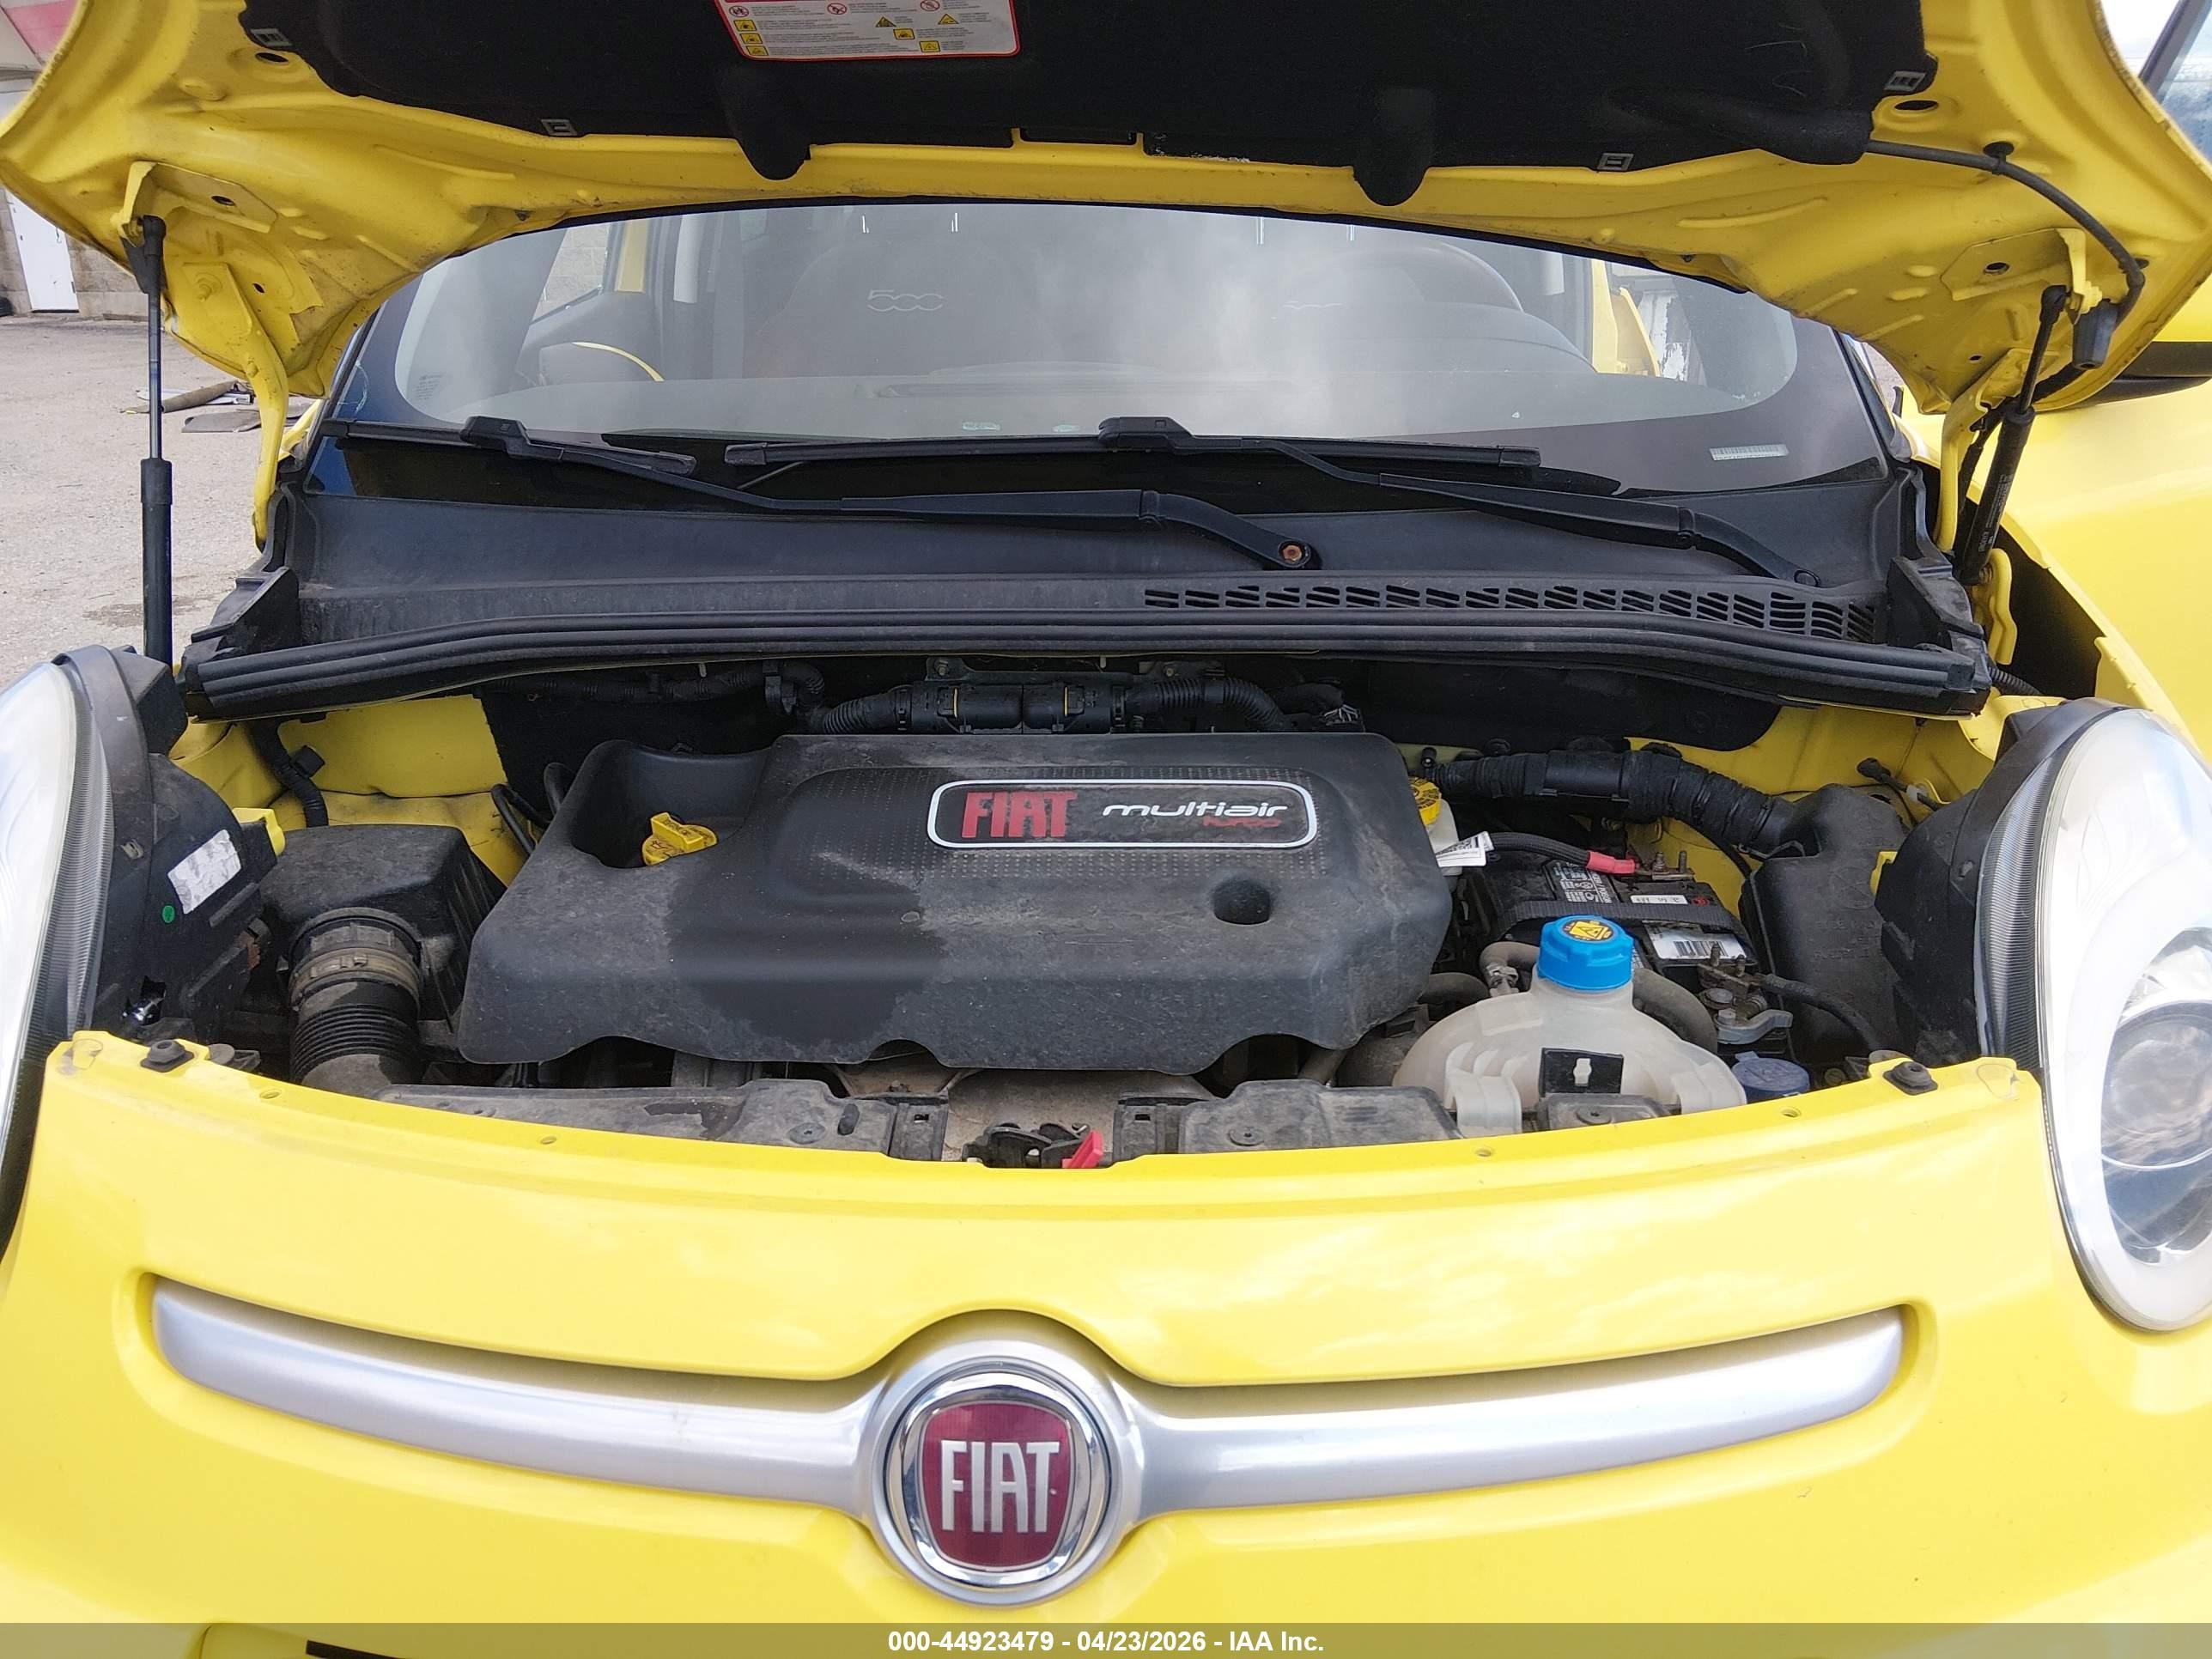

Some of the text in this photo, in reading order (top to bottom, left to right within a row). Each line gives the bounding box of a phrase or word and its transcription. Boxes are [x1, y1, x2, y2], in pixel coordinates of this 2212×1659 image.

[867, 289, 944, 312] 500
[962, 791, 1288, 838] FIAT multiair
[941, 1440, 1060, 1534] FIAT
